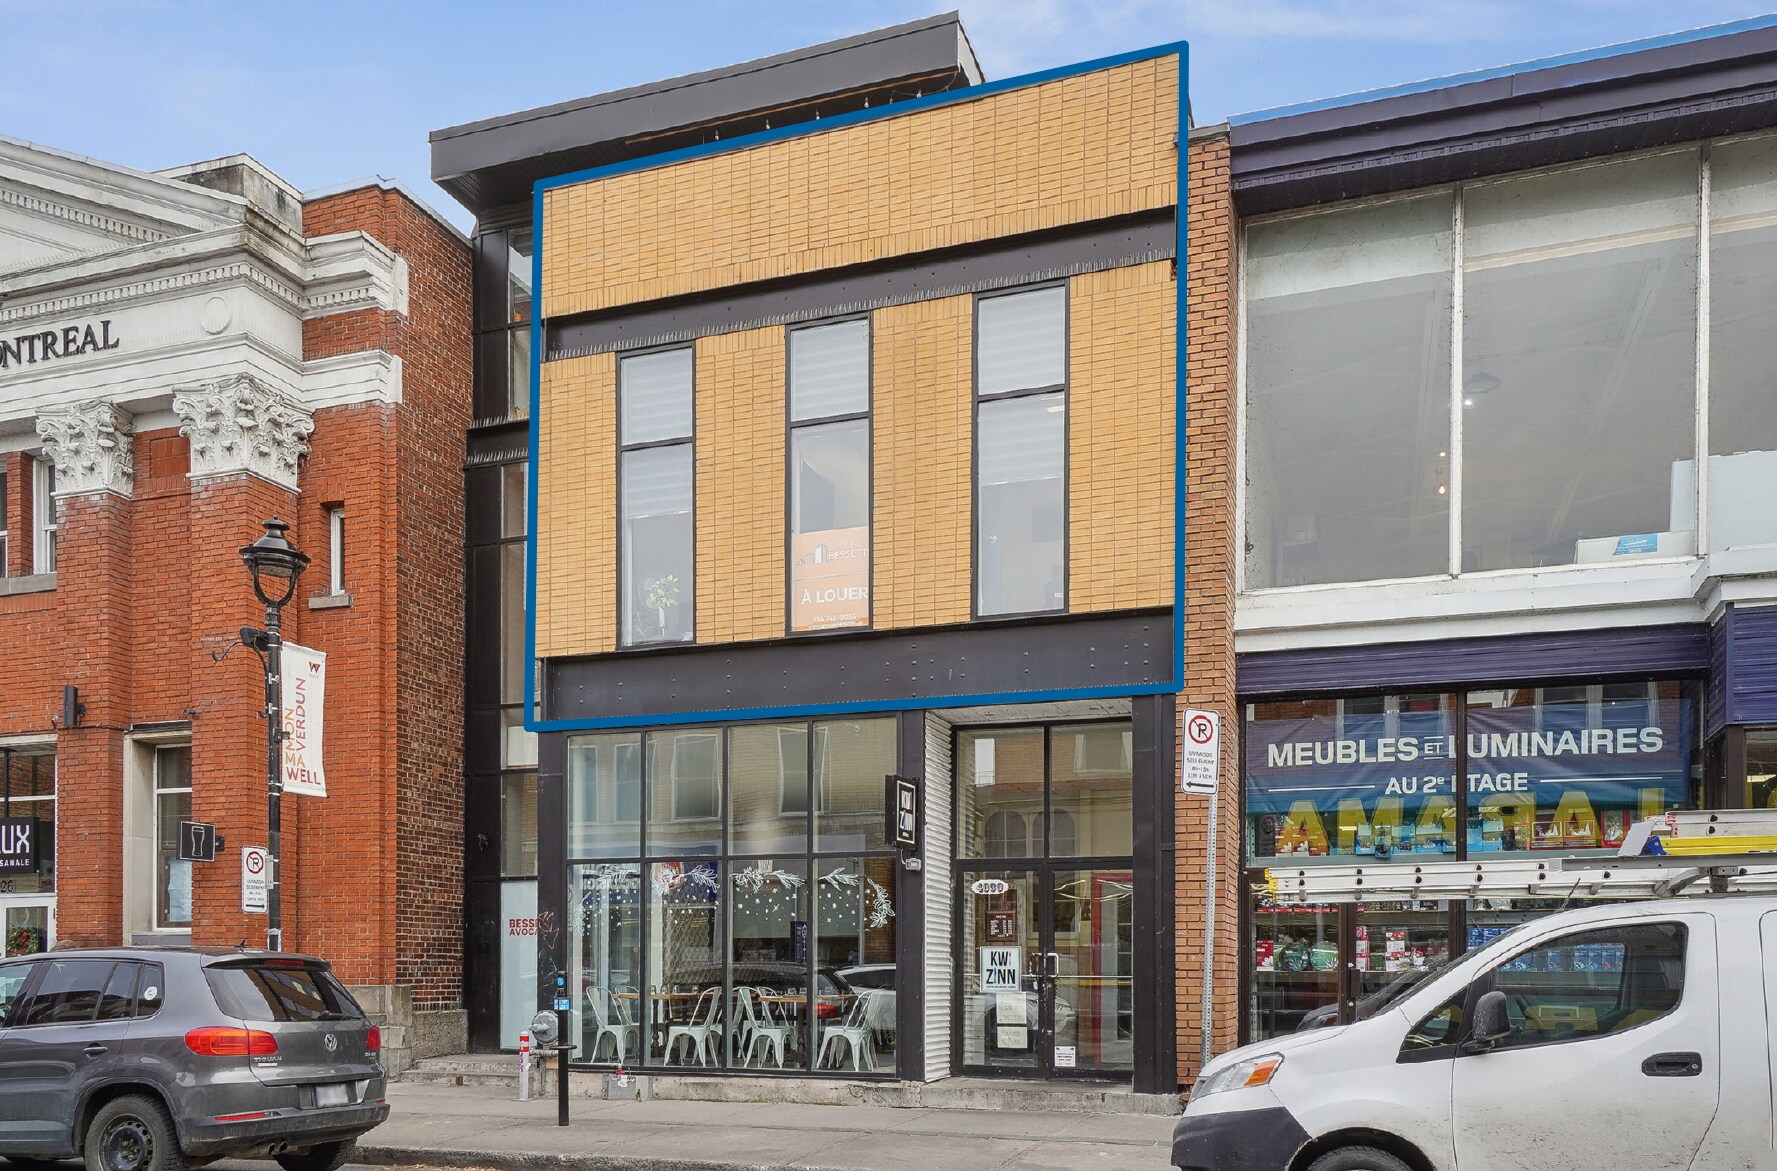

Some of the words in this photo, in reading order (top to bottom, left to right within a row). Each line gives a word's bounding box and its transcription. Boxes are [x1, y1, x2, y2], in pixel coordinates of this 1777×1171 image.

[0, 320, 119, 368] NTREAL
[801, 588, 812, 605] À
[816, 586, 869, 604] LOUER
[295, 677, 306, 752] VERDUN
[285, 752, 305, 768] MA
[1268, 737, 1419, 767] MEUBLES
[1424, 742, 1443, 754] ET
[286, 766, 321, 785] WELL
[1385, 776, 1417, 795] AU
[0, 824, 30, 854] UX
[0, 880, 14, 893] 26
